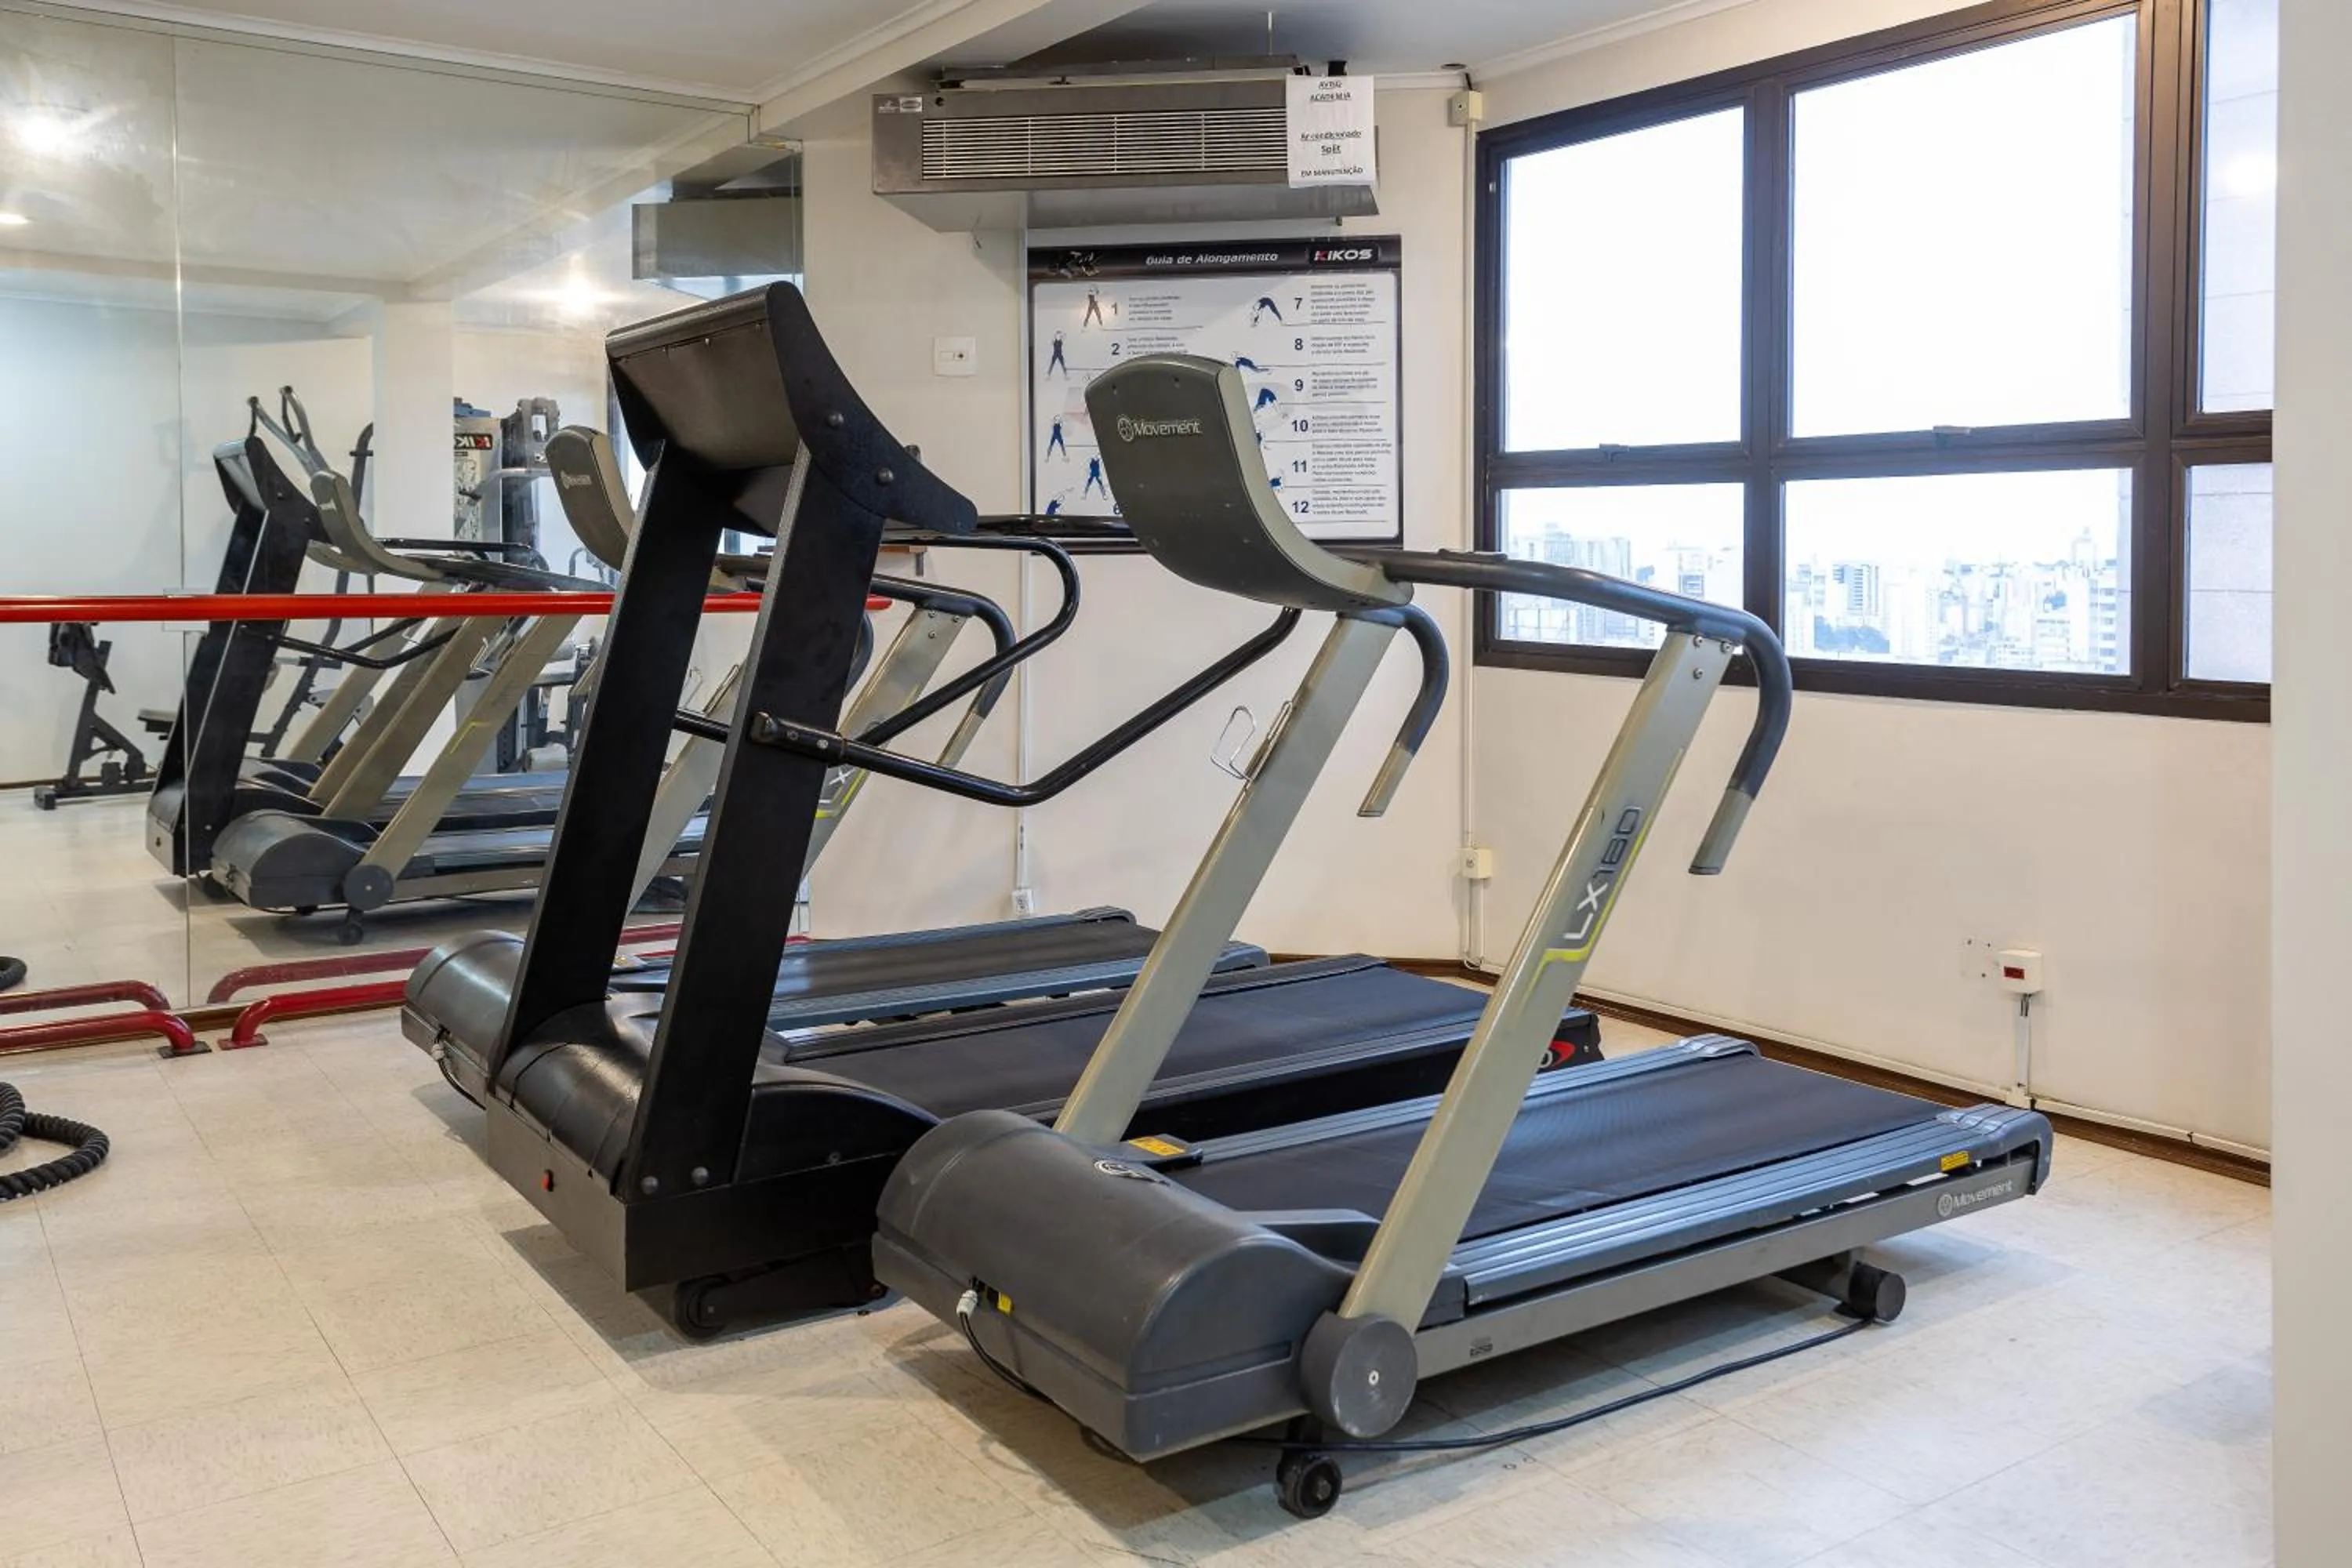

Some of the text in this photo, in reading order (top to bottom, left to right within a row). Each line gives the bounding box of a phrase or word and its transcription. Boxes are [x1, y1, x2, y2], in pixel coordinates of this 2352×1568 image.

[1310, 92, 1351, 102] ACADEMIA
[1321, 144, 1341, 154] Split
[1145, 252, 1279, 266] Guia de Alongamento
[1313, 249, 1373, 261] KIKOS
[1111, 302, 1117, 314] 1
[1294, 297, 1303, 310] 7
[1111, 343, 1120, 355] 2
[1294, 338, 1303, 350] 8
[1294, 379, 1303, 391] 9
[1132, 421, 1203, 436] Movement
[1291, 419, 1308, 432] 10
[1291, 460, 1307, 473] 11
[1291, 501, 1309, 514] 12
[1563, 805, 1643, 940] LX180
[1952, 1178, 2013, 1208] Movement
